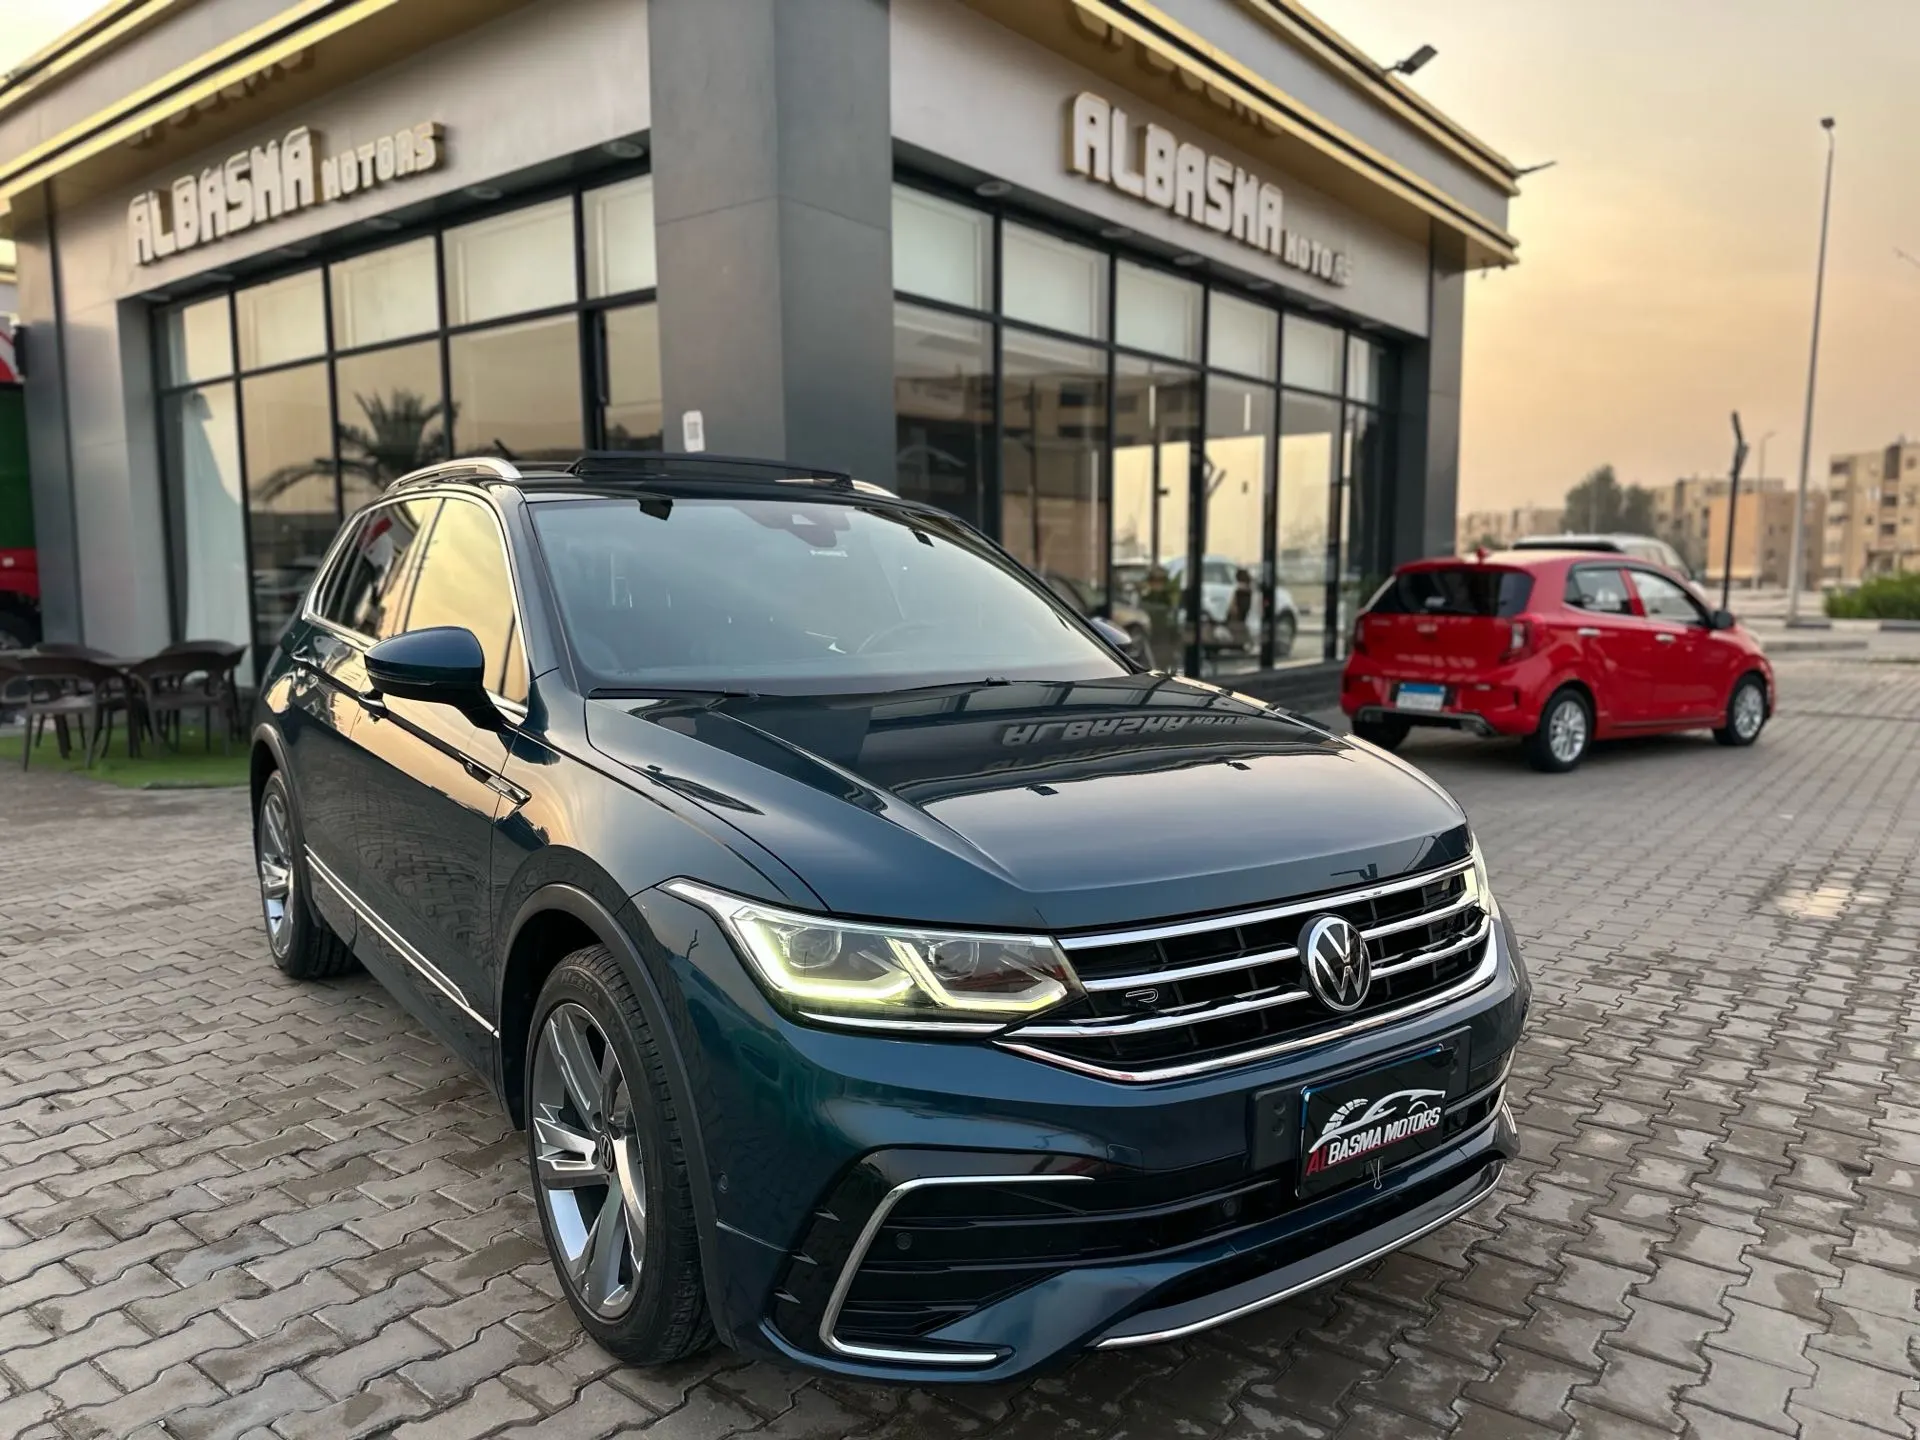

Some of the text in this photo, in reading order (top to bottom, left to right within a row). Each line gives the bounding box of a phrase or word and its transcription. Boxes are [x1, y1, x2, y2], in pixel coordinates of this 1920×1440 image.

[127, 122, 437, 265] ALBASMA MOTORS
[1073, 91, 1283, 256] ALBASMA
[1384, 1106, 1441, 1143] MOTORS
